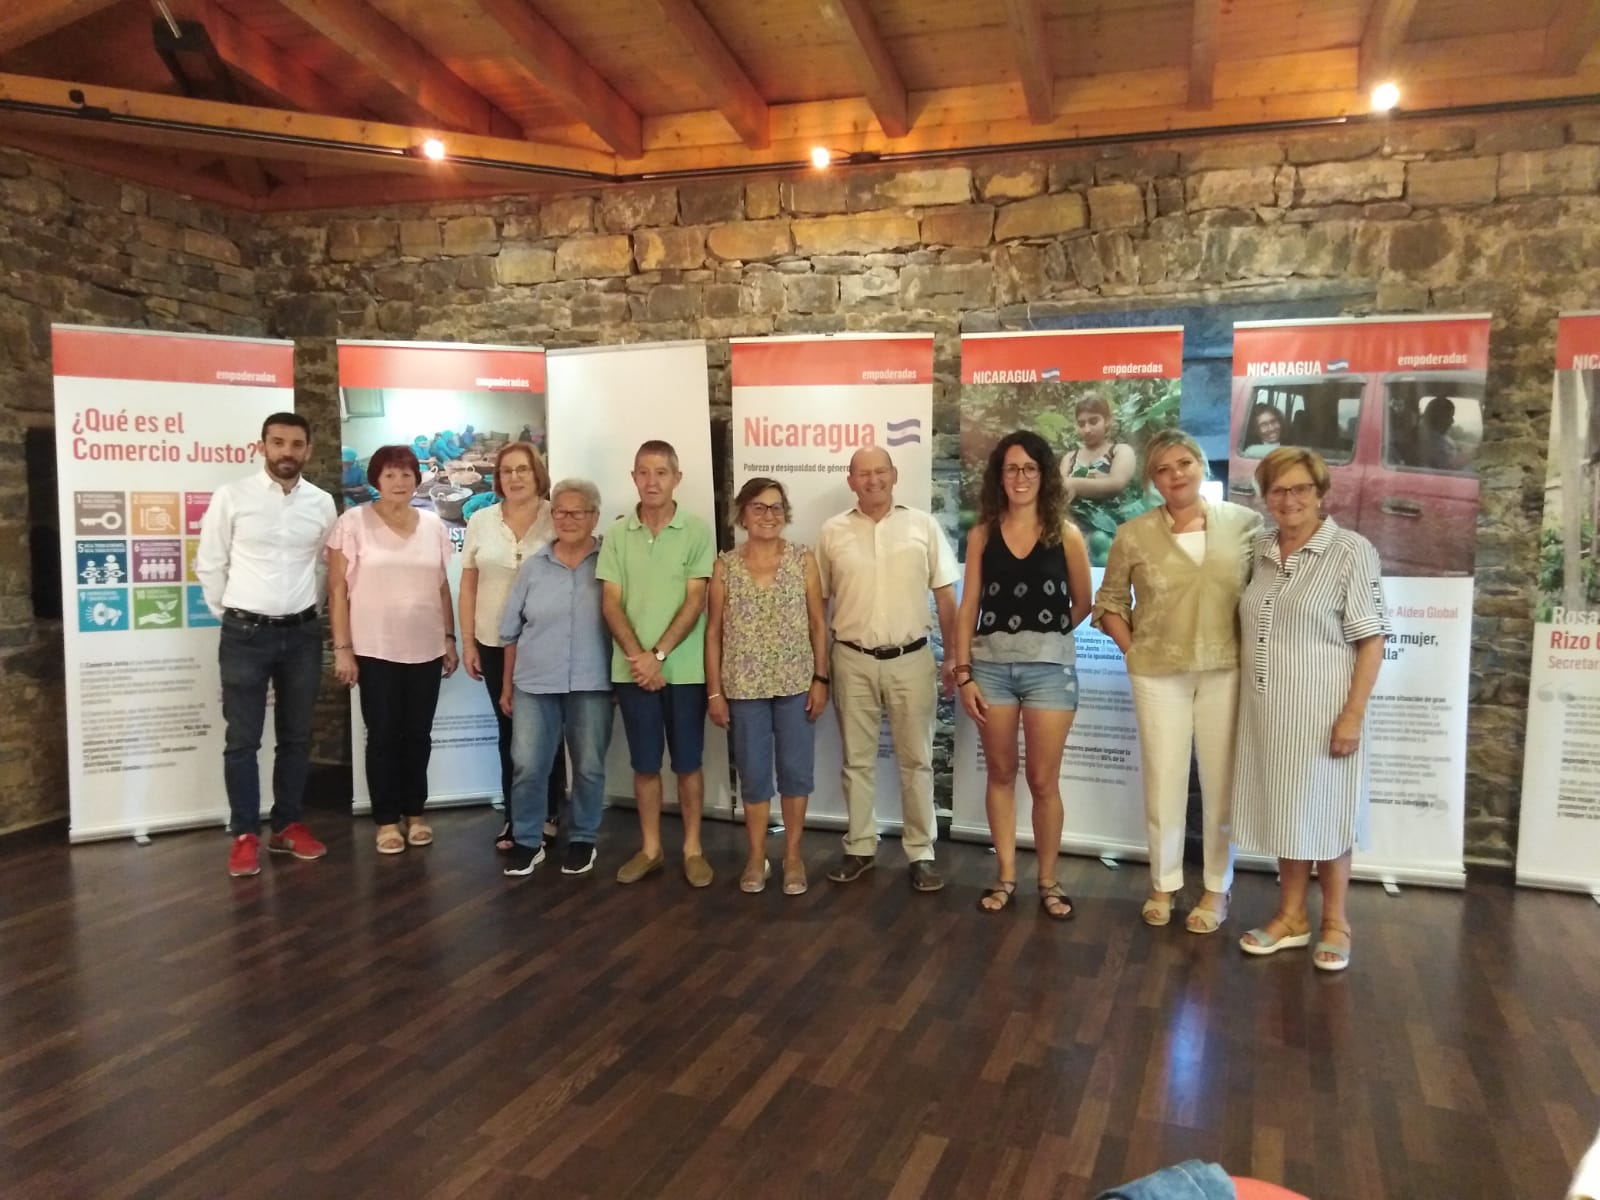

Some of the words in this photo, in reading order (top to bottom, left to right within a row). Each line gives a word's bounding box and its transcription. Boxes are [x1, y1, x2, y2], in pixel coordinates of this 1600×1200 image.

[1246, 360, 1322, 376] NICARAGUA
[1397, 353, 1468, 367] empoderadas
[1572, 354, 1600, 370] NIC
[215, 370, 277, 383] empoderadas
[475, 376, 530, 388] empoderadas
[862, 368, 917, 380] empoderadas
[973, 369, 1037, 384] NICARAGUA
[1102, 363, 1163, 375] empoderadas
[72, 408, 128, 435] ¿Qué
[134, 414, 159, 433] es
[164, 412, 184, 434] el
[743, 416, 875, 453] Nicaragua
[73, 437, 181, 462] Comercio
[186, 441, 258, 464] Justo?
[743, 463, 769, 472] Pobreza
[770, 464, 774, 473] y
[775, 463, 817, 473] desigualdad
[817, 463, 826, 472] de
[1396, 606, 1425, 618] Aldea
[1427, 607, 1459, 619] Global
[1552, 606, 1600, 625] Rosa
[1400, 632, 1439, 647] mujer,
[1550, 629, 1591, 650] Rizo
